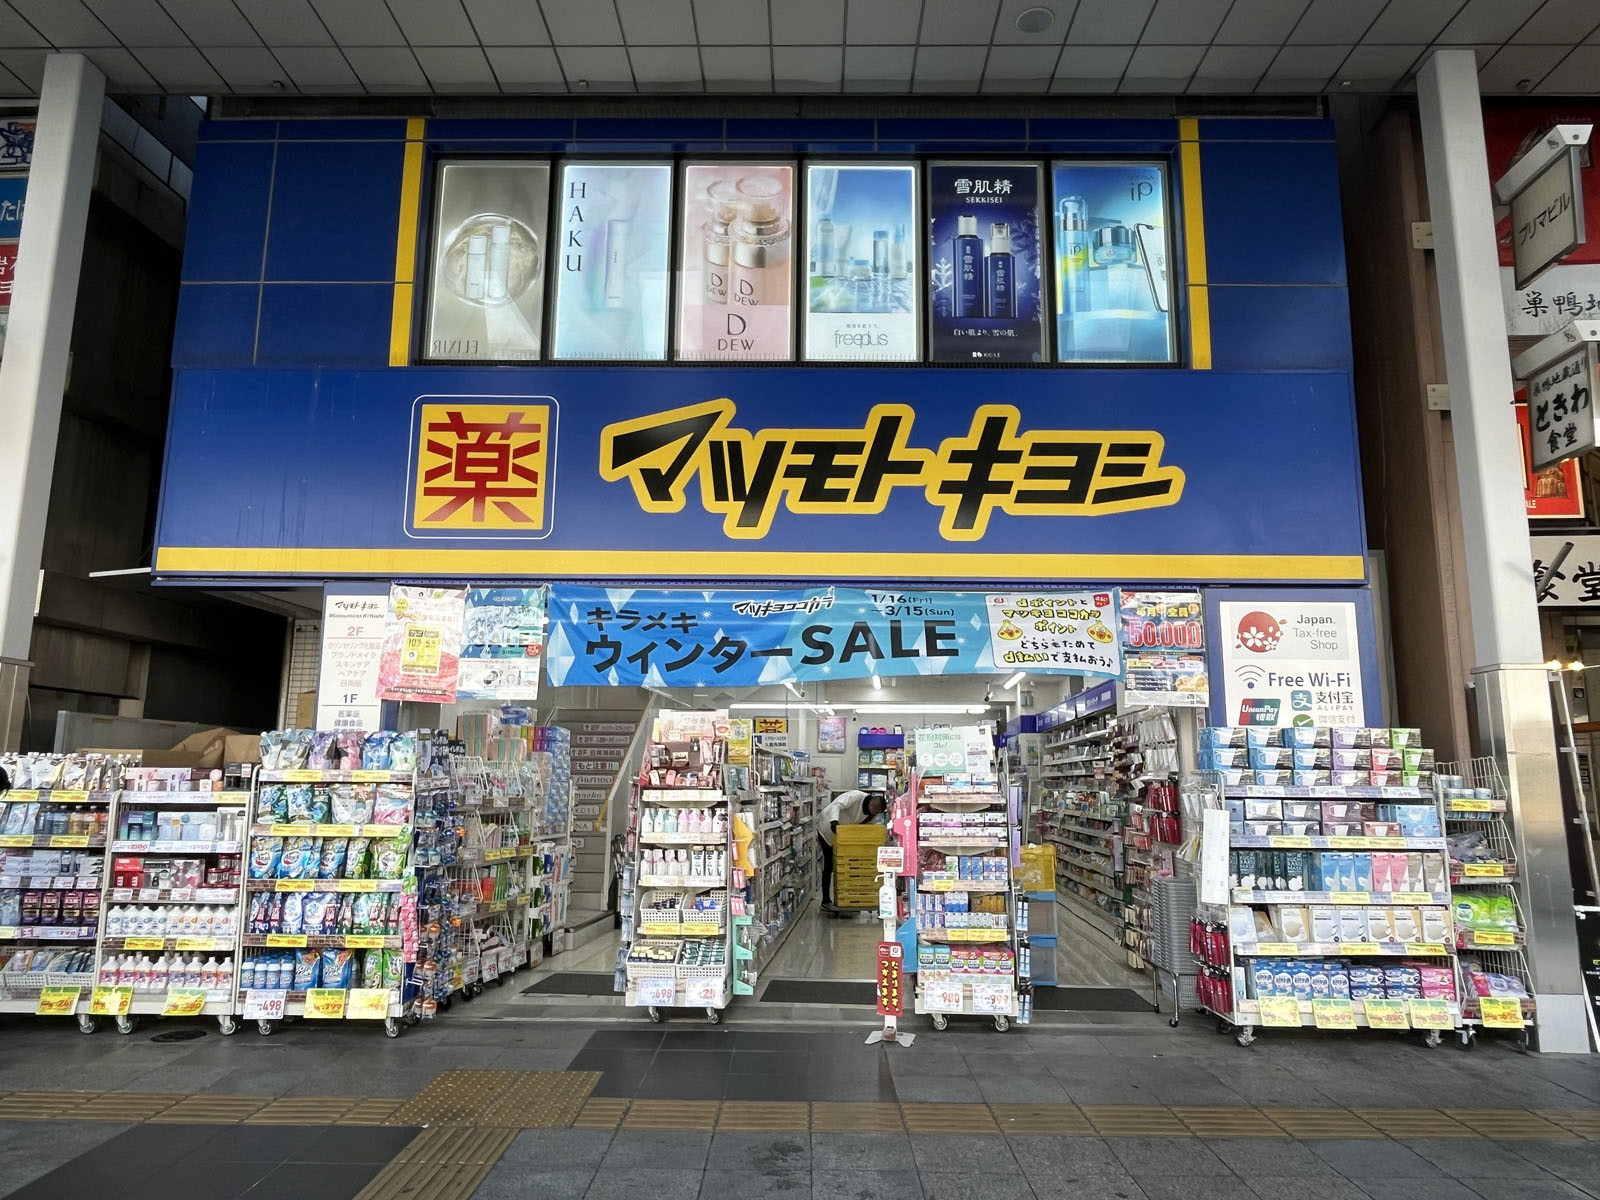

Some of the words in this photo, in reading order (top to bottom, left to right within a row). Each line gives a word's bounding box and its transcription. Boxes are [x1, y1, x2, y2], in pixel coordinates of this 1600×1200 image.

[955, 178, 1013, 195] 雪肌精
[566, 182, 586, 272] HAKU
[740, 279, 754, 296] D
[727, 313, 747, 336] D
[834, 329, 889, 349] freeplus
[953, 328, 1020, 337] 白い肌より、雪の肌。
[717, 338, 755, 351] DEW
[1536, 383, 1589, 432] ときわ
[1547, 422, 1578, 454] 食堂
[424, 404, 549, 524] 薬
[611, 409, 1175, 530] マツモトキヨシ
[733, 596, 835, 617] マツキヨココカラ
[586, 606, 699, 634] キラメキ
[1002, 609, 1102, 621] マツキヨココカラ
[347, 626, 364, 637] 2F
[1034, 619, 1078, 634] ポイント
[1293, 627, 1338, 639] Tax-free
[1020, 639, 1096, 650] どちらもためて
[1310, 640, 1339, 652] Shop
[336, 660, 370, 669] スキンケア
[1268, 673, 1304, 687] Free
[1309, 672, 1351, 687] Wi-Fi
[343, 693, 359, 704] 1F
[1315, 691, 1355, 704] 支付宝
[1242, 705, 1279, 716] UnionPay
[262, 1000, 282, 1011] 498
